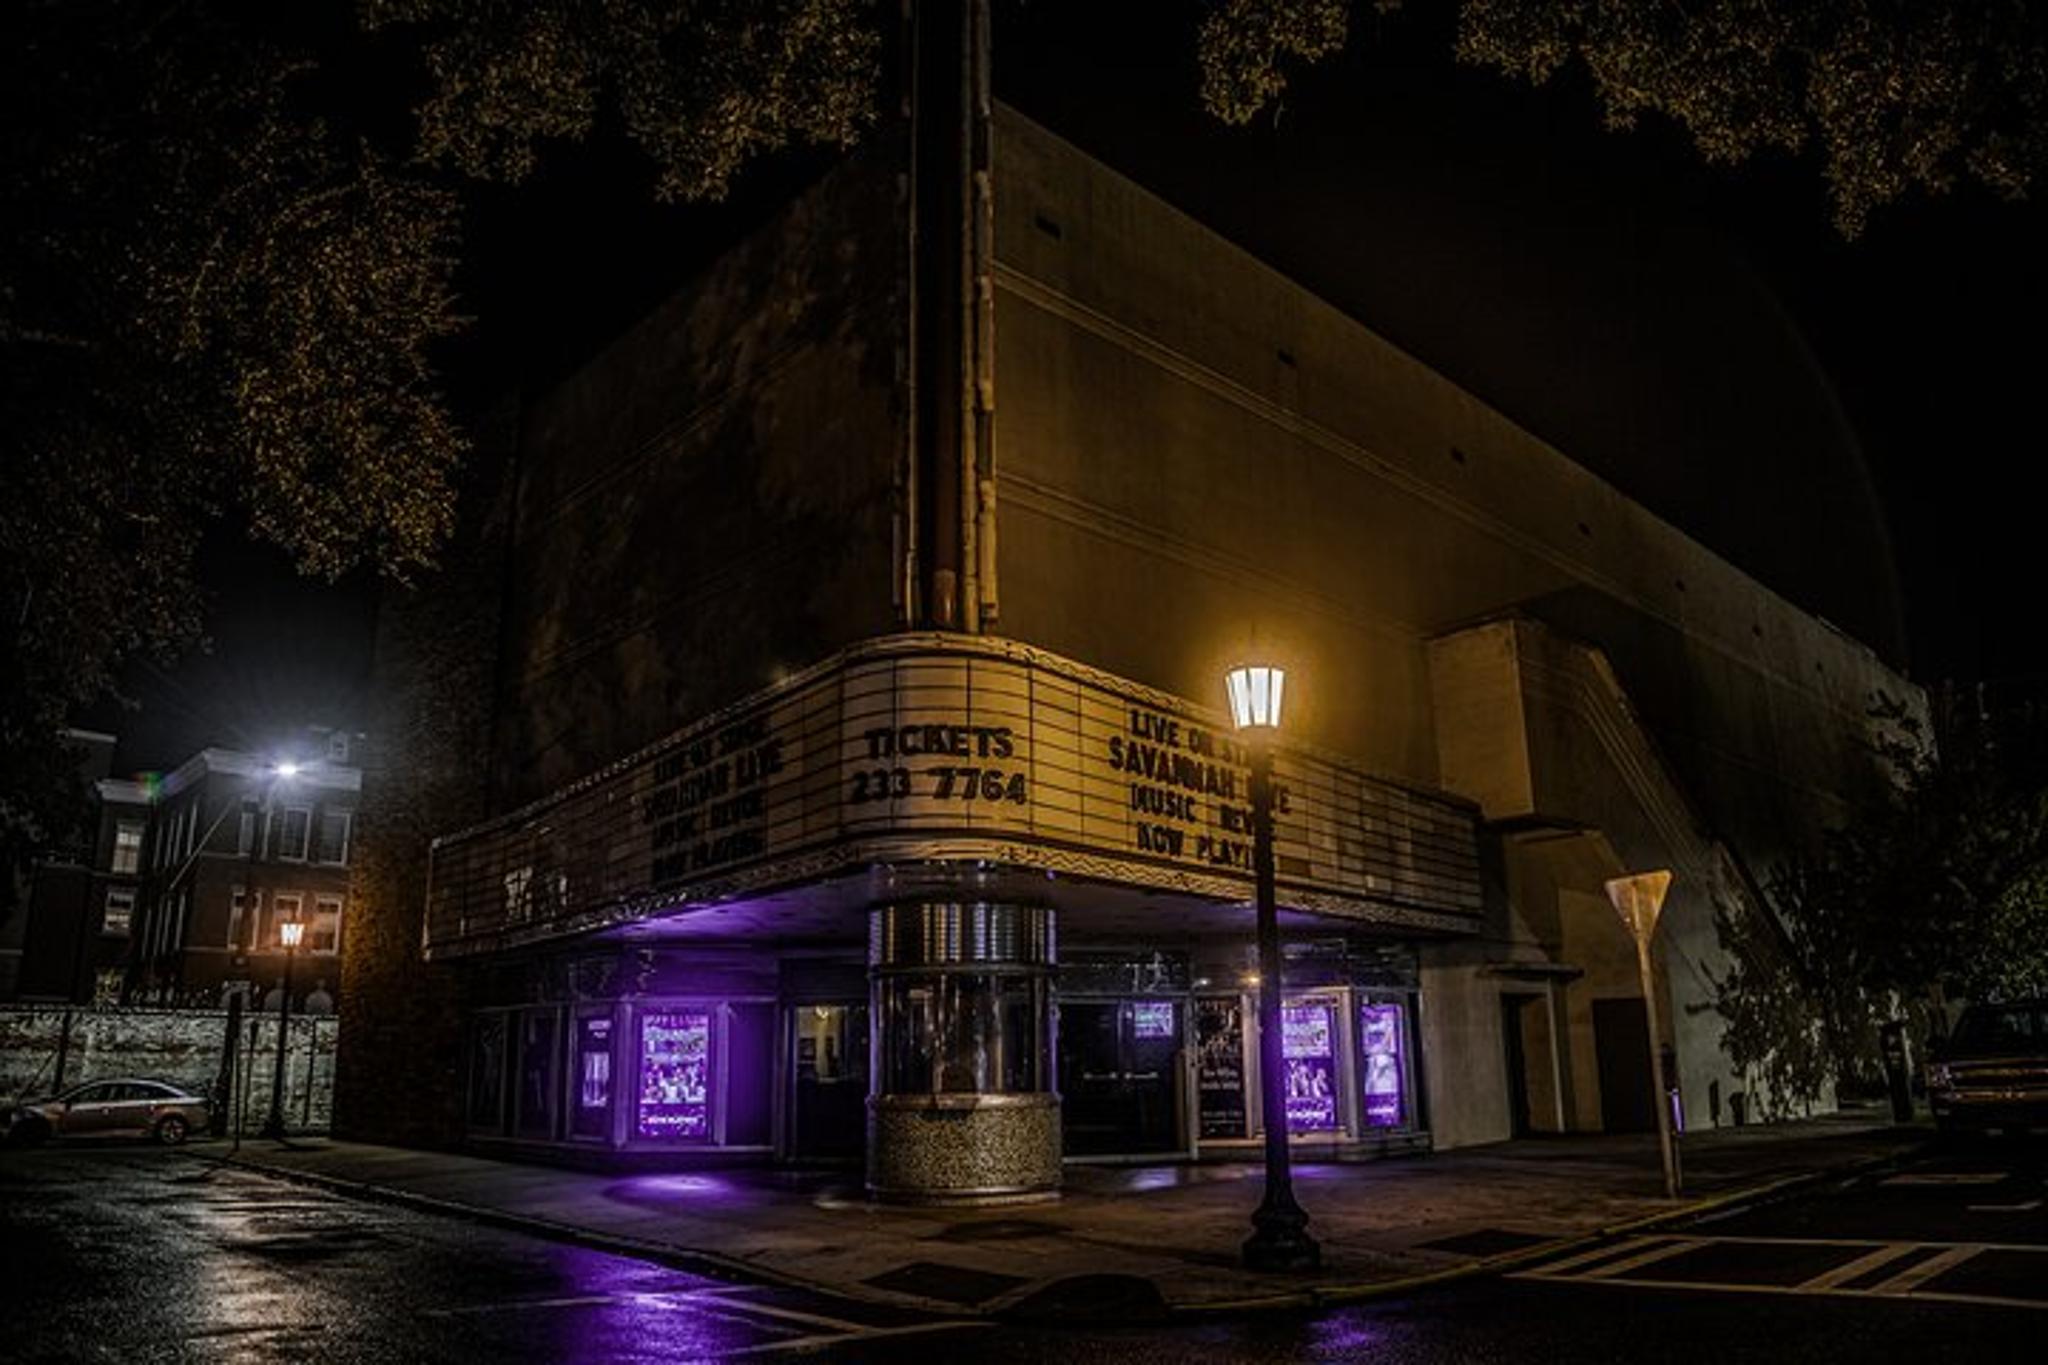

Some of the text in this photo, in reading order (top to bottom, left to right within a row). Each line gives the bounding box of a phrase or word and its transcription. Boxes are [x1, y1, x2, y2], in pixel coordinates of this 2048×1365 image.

[865, 724, 1014, 759] TICKETS
[1130, 709, 1180, 747] LIVE
[851, 766, 1027, 806] 233 7764
[1108, 735, 1236, 800] SAVANNAH
[1131, 781, 1255, 836] MUSIC REV
[1137, 821, 1251, 871] NOW PLAYI
